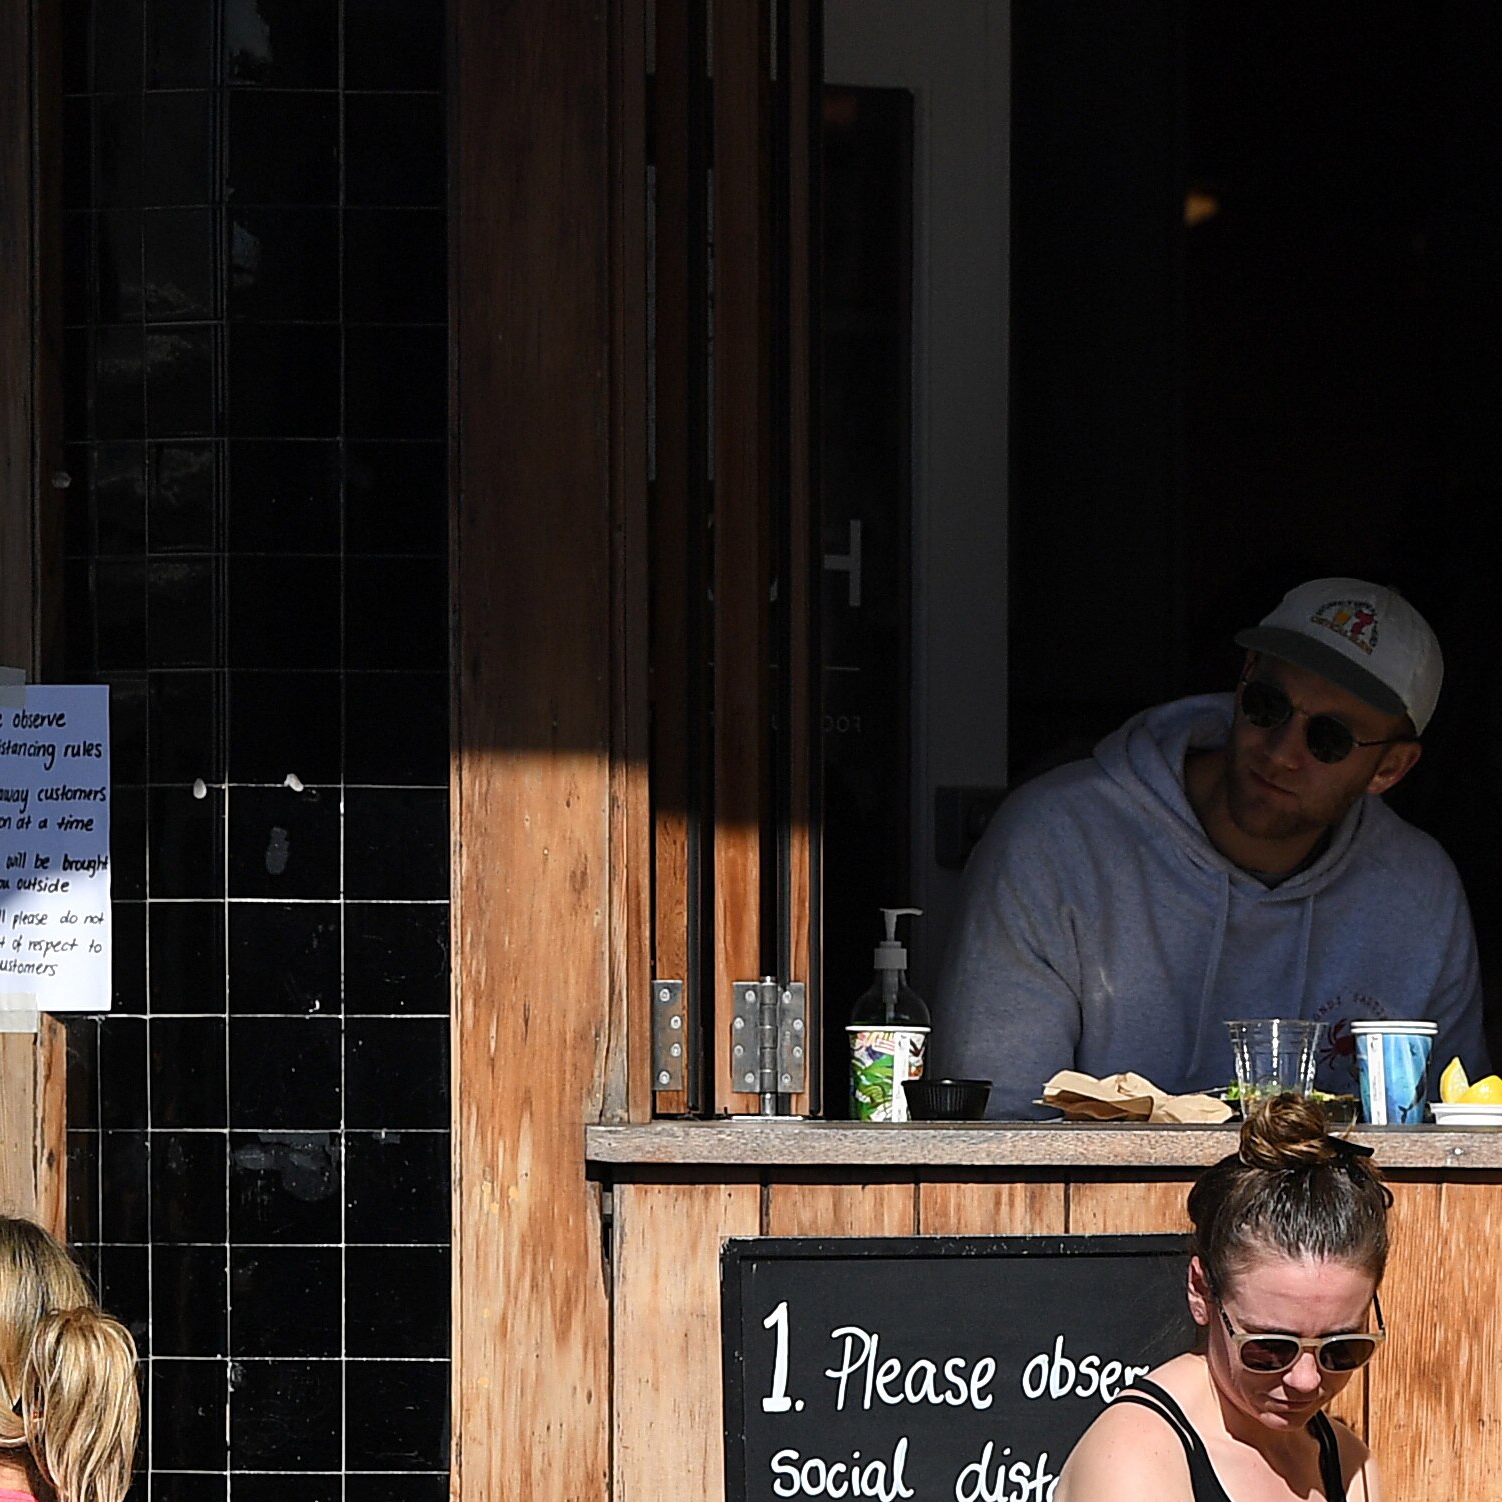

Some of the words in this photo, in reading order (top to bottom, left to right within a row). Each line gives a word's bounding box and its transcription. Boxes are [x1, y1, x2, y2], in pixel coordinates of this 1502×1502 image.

[12, 708, 67, 730] observe
[63, 740, 103, 759] rules
[37, 784, 107, 802] customers
[16, 814, 33, 831] at
[38, 817, 48, 830] a
[57, 814, 95, 832] time
[5, 851, 28, 870] will
[34, 853, 51, 870] be
[62, 852, 109, 879] brought
[16, 876, 70, 894] outside
[11, 909, 48, 931] please
[59, 909, 79, 925] do
[83, 911, 105, 926] not
[11, 934, 23, 954] of
[28, 937, 79, 959] respect
[88, 938, 103, 954] to
[762, 1301, 805, 1413] 1.
[824, 1326, 996, 1411] Please
